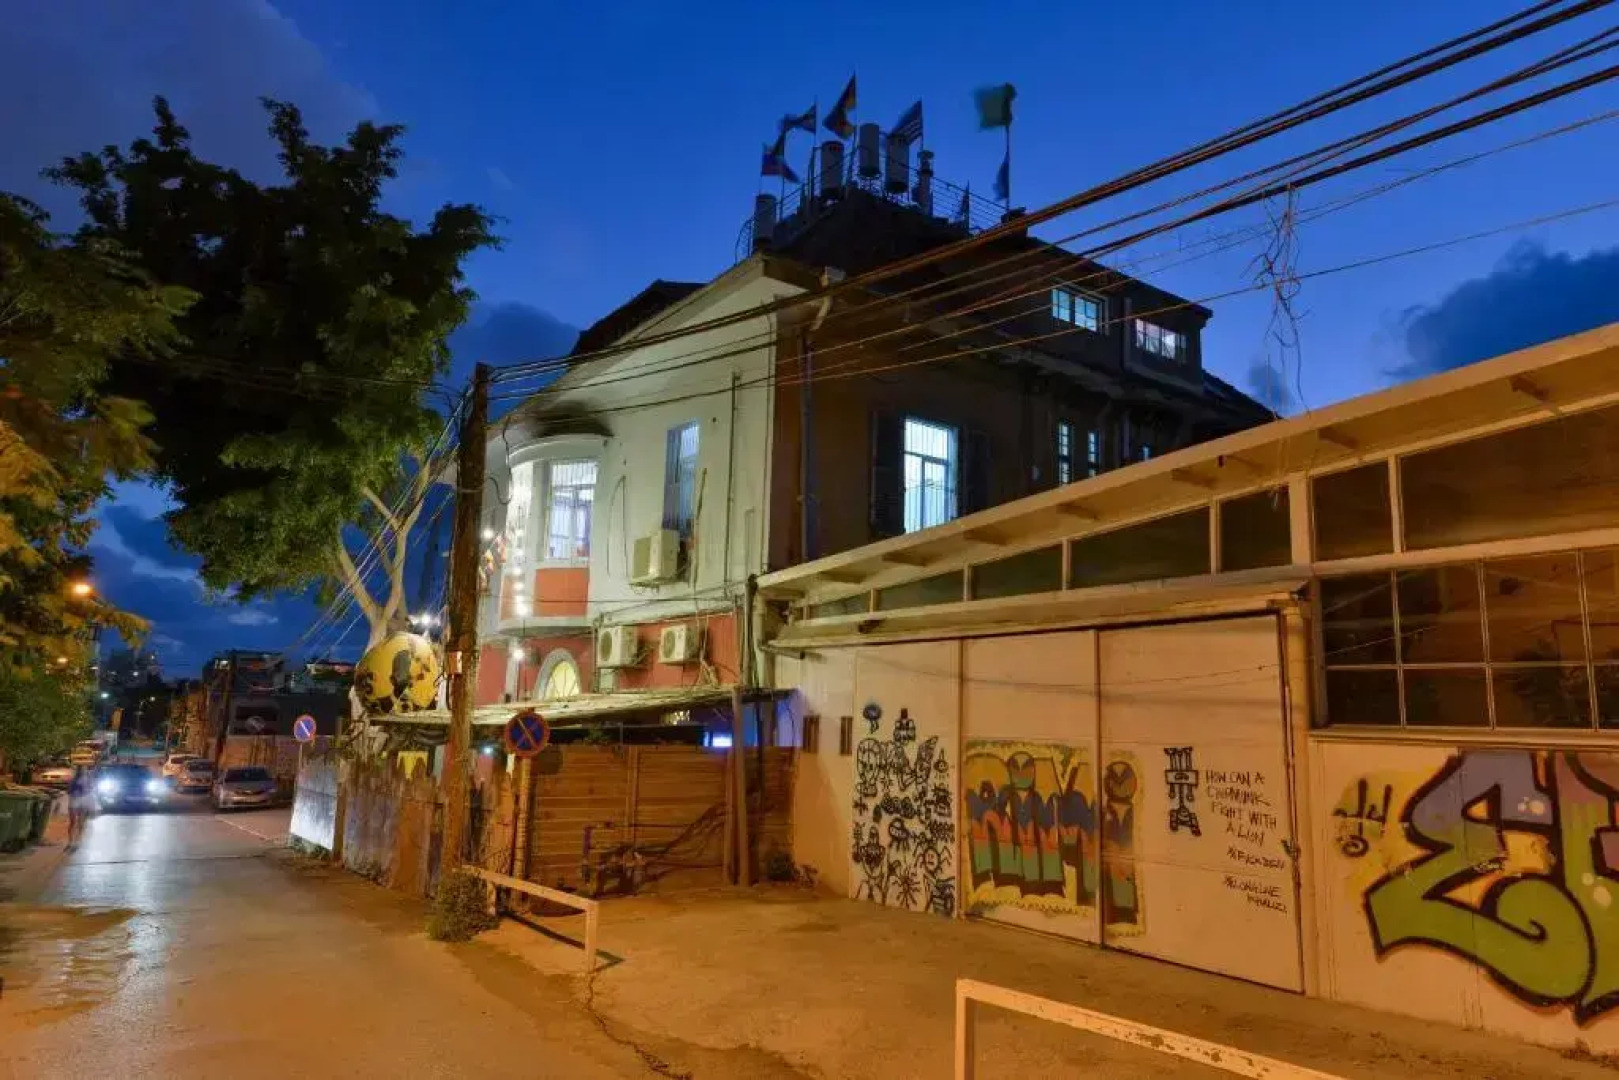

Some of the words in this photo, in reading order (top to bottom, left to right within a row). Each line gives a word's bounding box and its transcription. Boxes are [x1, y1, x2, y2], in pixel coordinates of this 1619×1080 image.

[1206, 770, 1226, 783] HOW
[1230, 771, 1251, 787] CAN
[1254, 771, 1265, 784] A
[1211, 801, 1243, 820] FIGHT
[1248, 810, 1277, 829] WITH
[1226, 821, 1234, 833] A
[1237, 824, 1265, 846] LION
